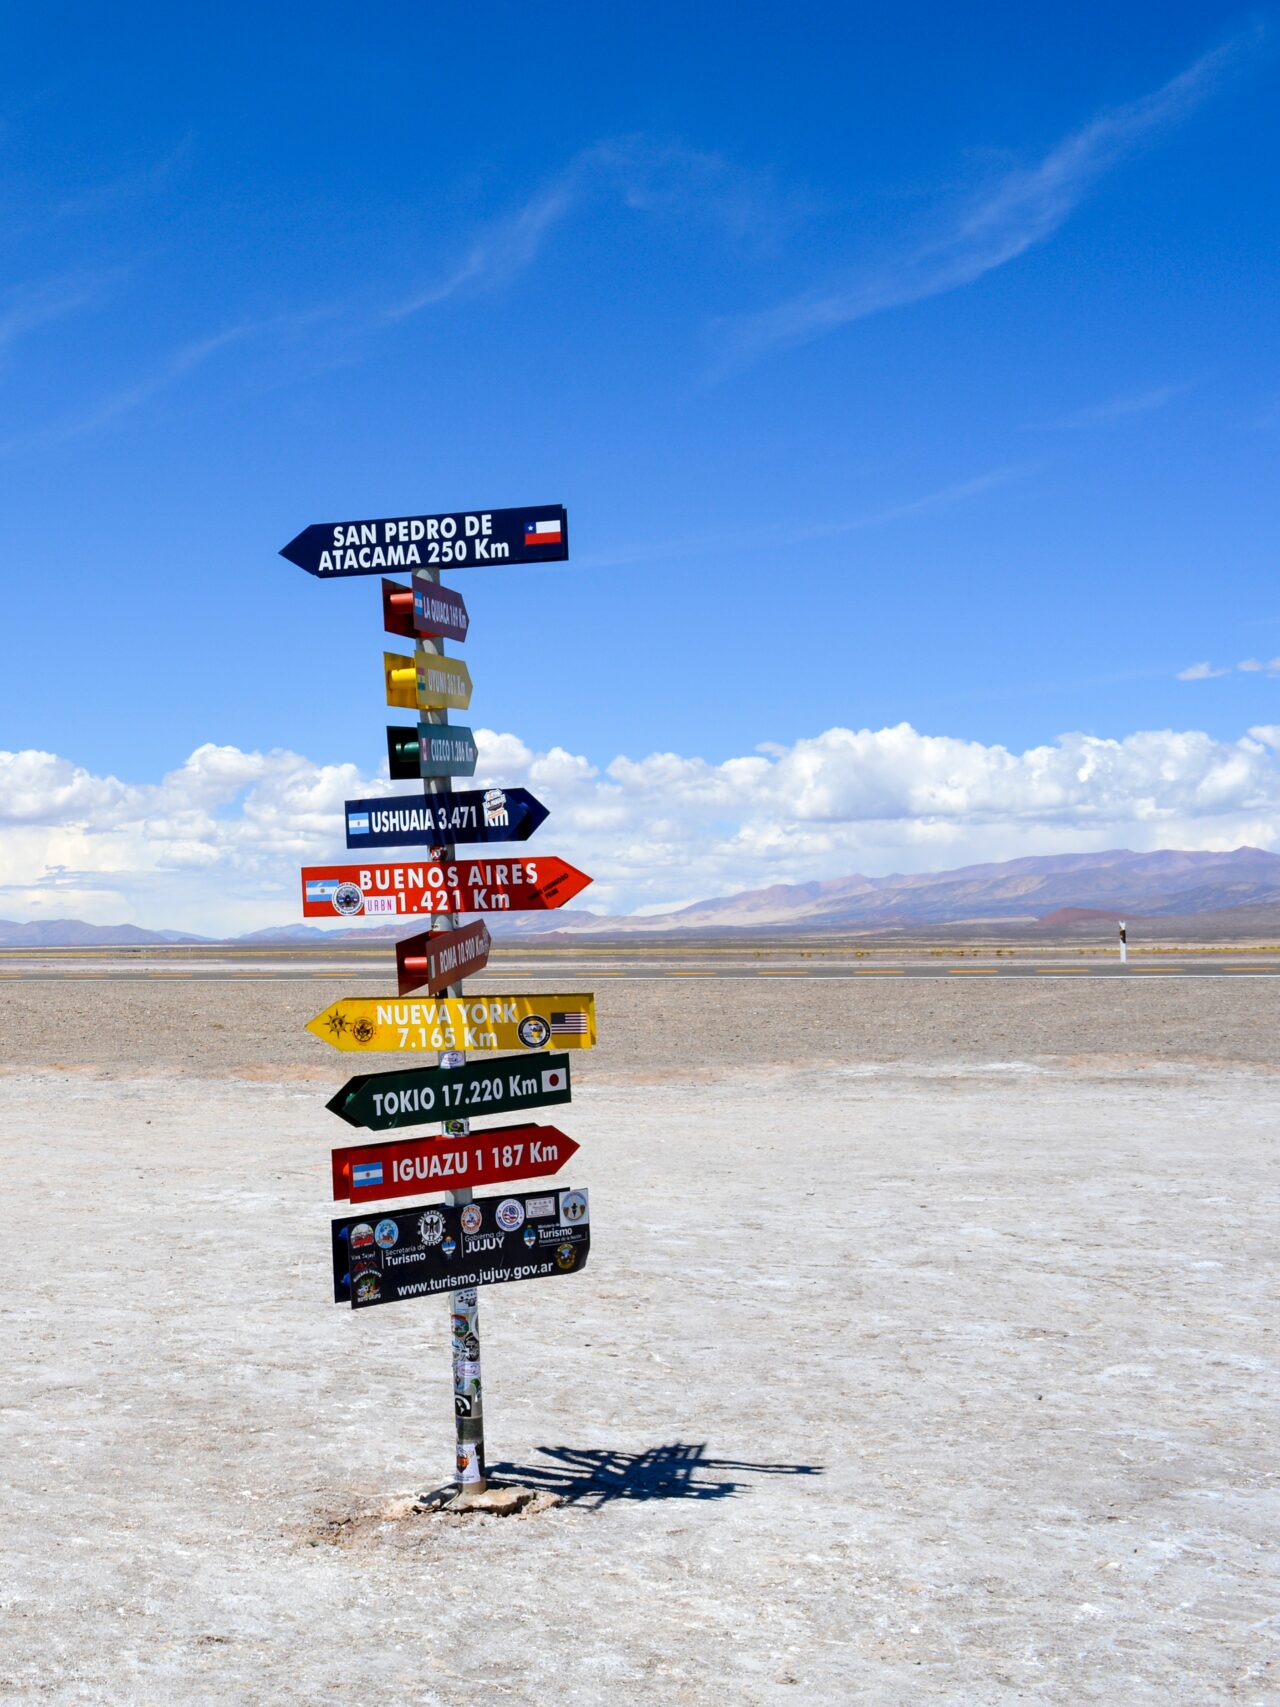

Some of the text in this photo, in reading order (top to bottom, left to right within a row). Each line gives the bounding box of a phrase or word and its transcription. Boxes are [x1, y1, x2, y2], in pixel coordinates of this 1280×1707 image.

[333, 514, 493, 547] SAN PEDRO DE
[318, 538, 509, 571] ATACAMA 250 Km
[423, 595, 431, 620] LA
[431, 598, 450, 625] QUIACA
[459, 607, 467, 629] Km
[428, 668, 447, 694] UYUNI
[457, 675, 466, 697] Km
[431, 738, 450, 762] CUZCO
[465, 741, 474, 762] Km
[371, 808, 435, 833] USHUAIA
[438, 805, 477, 830] 3.471
[359, 866, 459, 891] BUENOS
[467, 862, 539, 887] AIRES
[397, 888, 510, 912] 1.421 Km
[440, 945, 458, 974] ROMA
[475, 934, 485, 957] Km
[376, 1002, 518, 1025] NUEVA YORK
[397, 1028, 456, 1049] 7.165
[464, 1027, 498, 1048] Km
[372, 1074, 538, 1117] TOKIO 17.220 Km
[392, 1150, 468, 1183] IGUAZU
[529, 1141, 558, 1164] Km
[464, 1232, 495, 1242] Gobierno
[465, 1237, 505, 1253] JUJUY
[537, 1227, 573, 1240] Turismo
[385, 1252, 426, 1267] Turismo
[397, 1261, 554, 1297] www.turismo.jujuy.gov.ar
